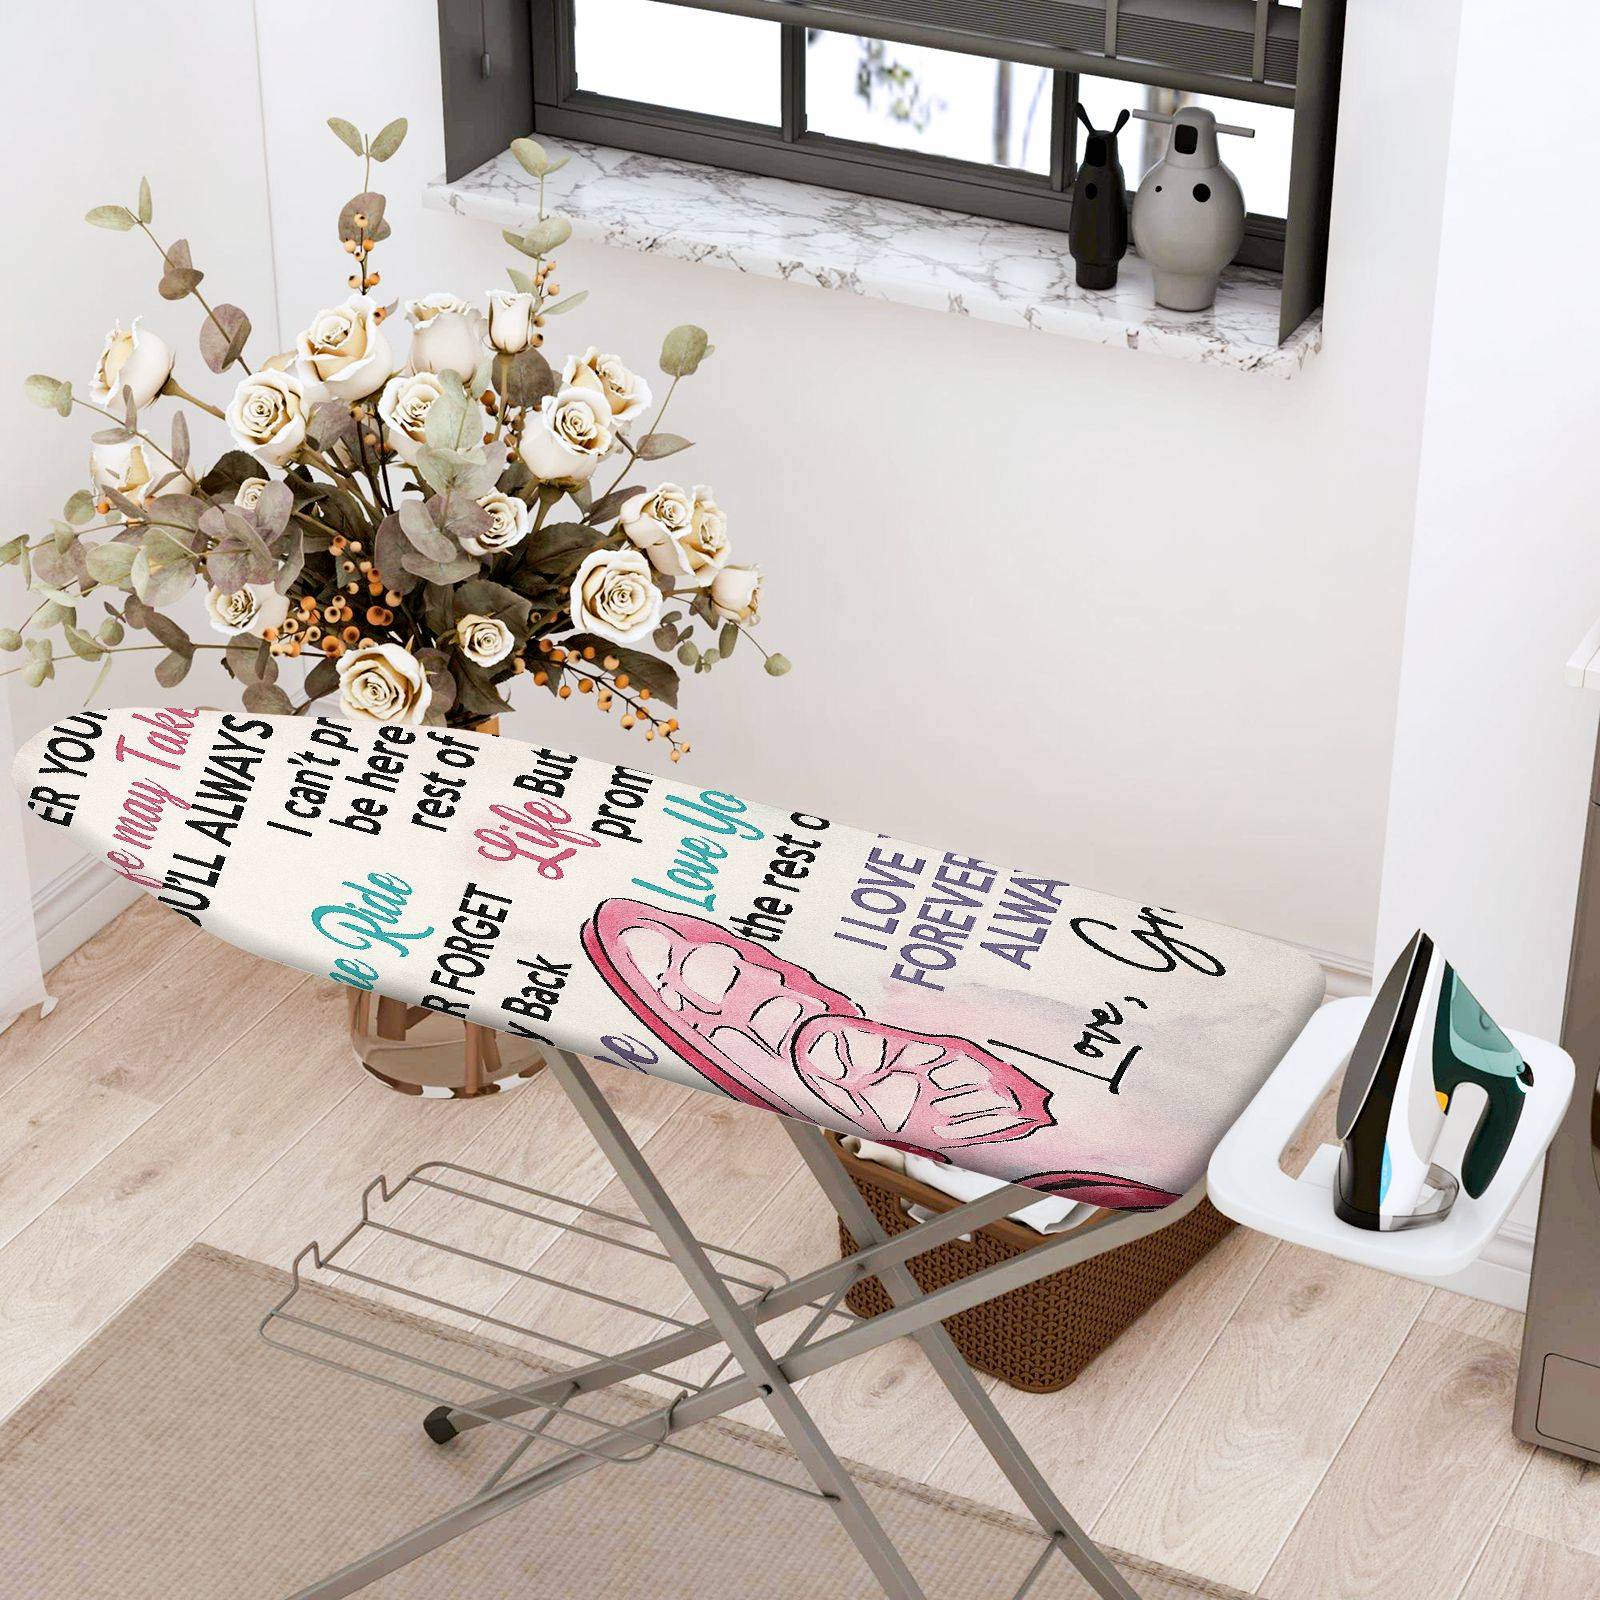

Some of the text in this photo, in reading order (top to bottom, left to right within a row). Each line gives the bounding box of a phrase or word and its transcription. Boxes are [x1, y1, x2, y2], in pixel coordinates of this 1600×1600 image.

[27, 785, 80, 828] ER
[112, 778, 191, 850] may
[158, 714, 273, 926] U'LL ALWAYS
[284, 752, 341, 819] can't
[328, 725, 416, 835] be here
[411, 731, 480, 832] rest of
[473, 747, 601, 880] Life But
[631, 790, 765, 912] Love Yo
[729, 895, 795, 944] the
[763, 834, 823, 893] rest
[841, 847, 926, 936] LOVE
[311, 872, 434, 957] Ride
[430, 882, 513, 996] FORGET
[890, 851, 998, 992] FOREVER
[979, 869, 1069, 971] ALWA
[1069, 906, 1226, 977] Gr
[501, 954, 572, 1022] Back
[988, 996, 1148, 1096] Love,
